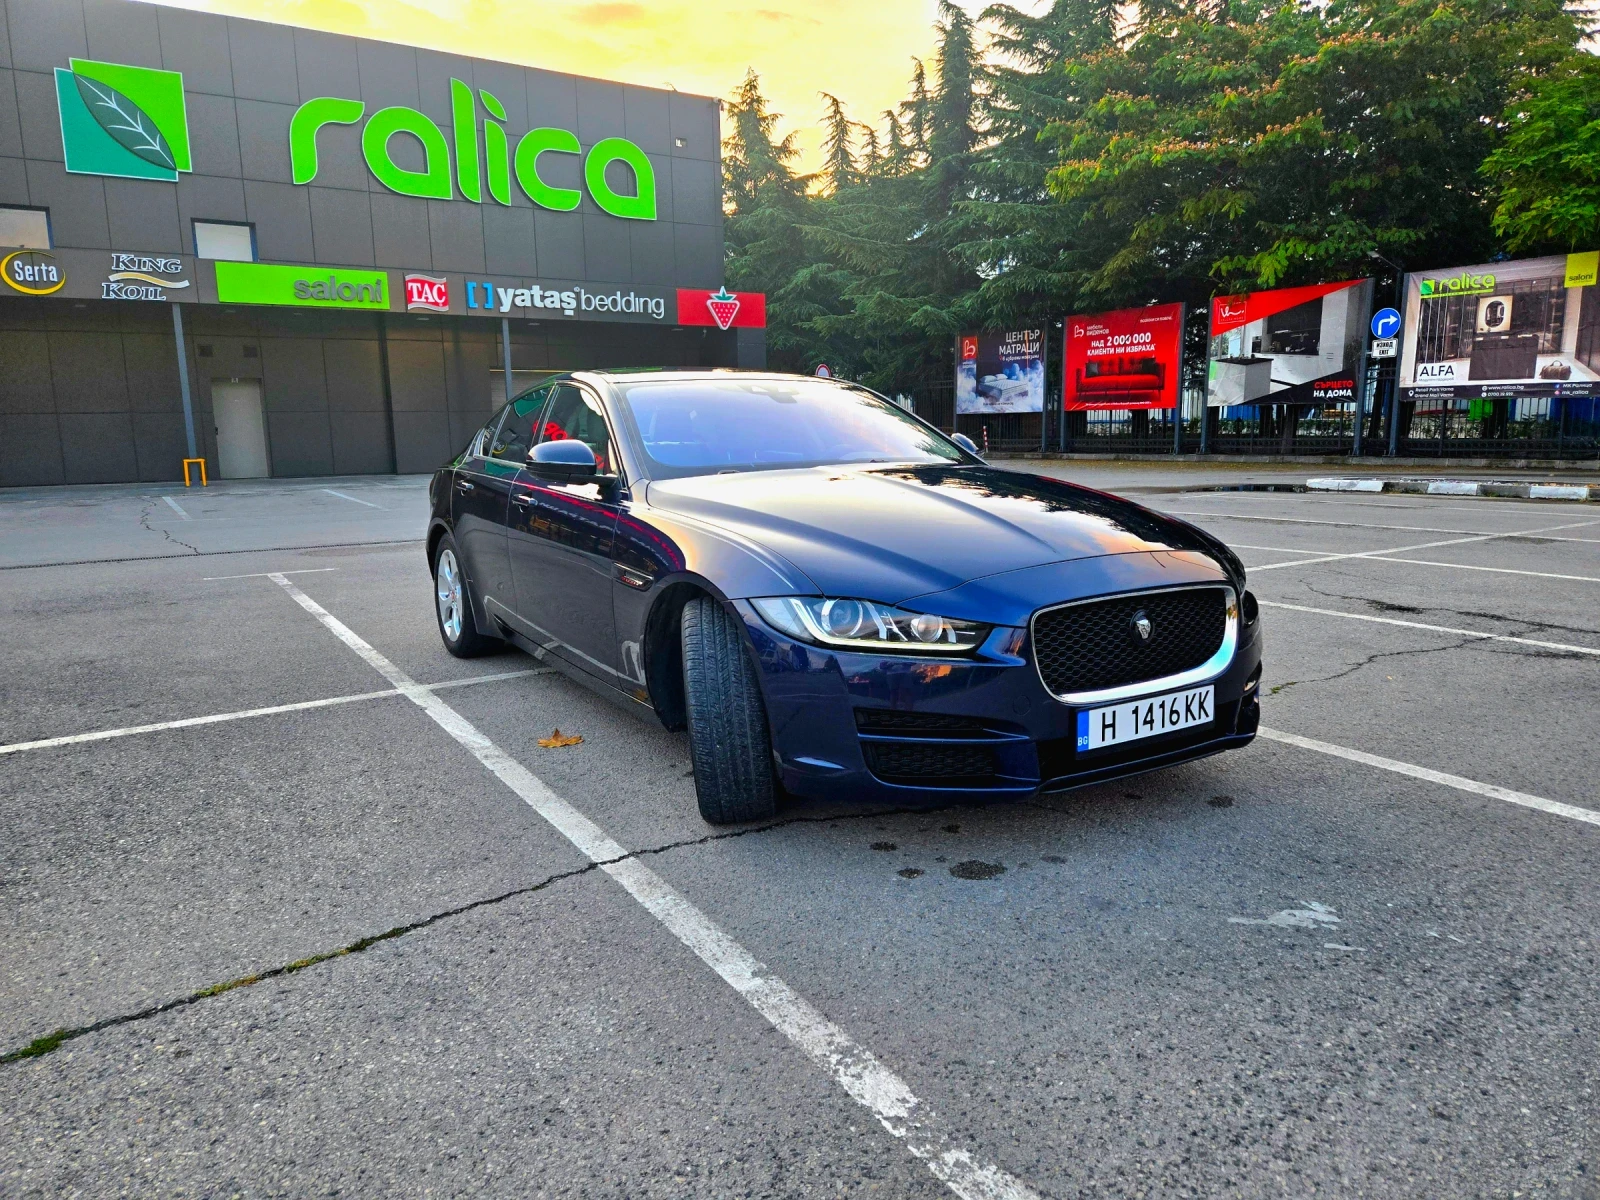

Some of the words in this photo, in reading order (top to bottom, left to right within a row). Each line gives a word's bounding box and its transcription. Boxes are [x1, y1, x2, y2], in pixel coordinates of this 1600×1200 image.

[289, 77, 657, 220] ralica
[112, 253, 182, 273] KING
[13, 260, 58, 282] Serta
[1568, 273, 1593, 282] saloni
[1438, 272, 1496, 291] ralica
[102, 283, 166, 300] KOIL
[294, 276, 382, 303] saloni
[408, 282, 446, 307] TAÇ
[1005, 329, 1040, 343] ЦЕНТЪР
[1091, 339, 1104, 347] НАД
[999, 342, 1040, 355] МАТРАЦИ
[1087, 347, 1114, 356] КЛИЕНТИ
[1116, 346, 1125, 354] НИ
[1420, 365, 1454, 376] ALFA
[1314, 380, 1353, 389] СЪРЦЕТО
[1326, 388, 1352, 398] ДОМА
[1102, 710, 1116, 742] H
[1078, 736, 1088, 747] BG
